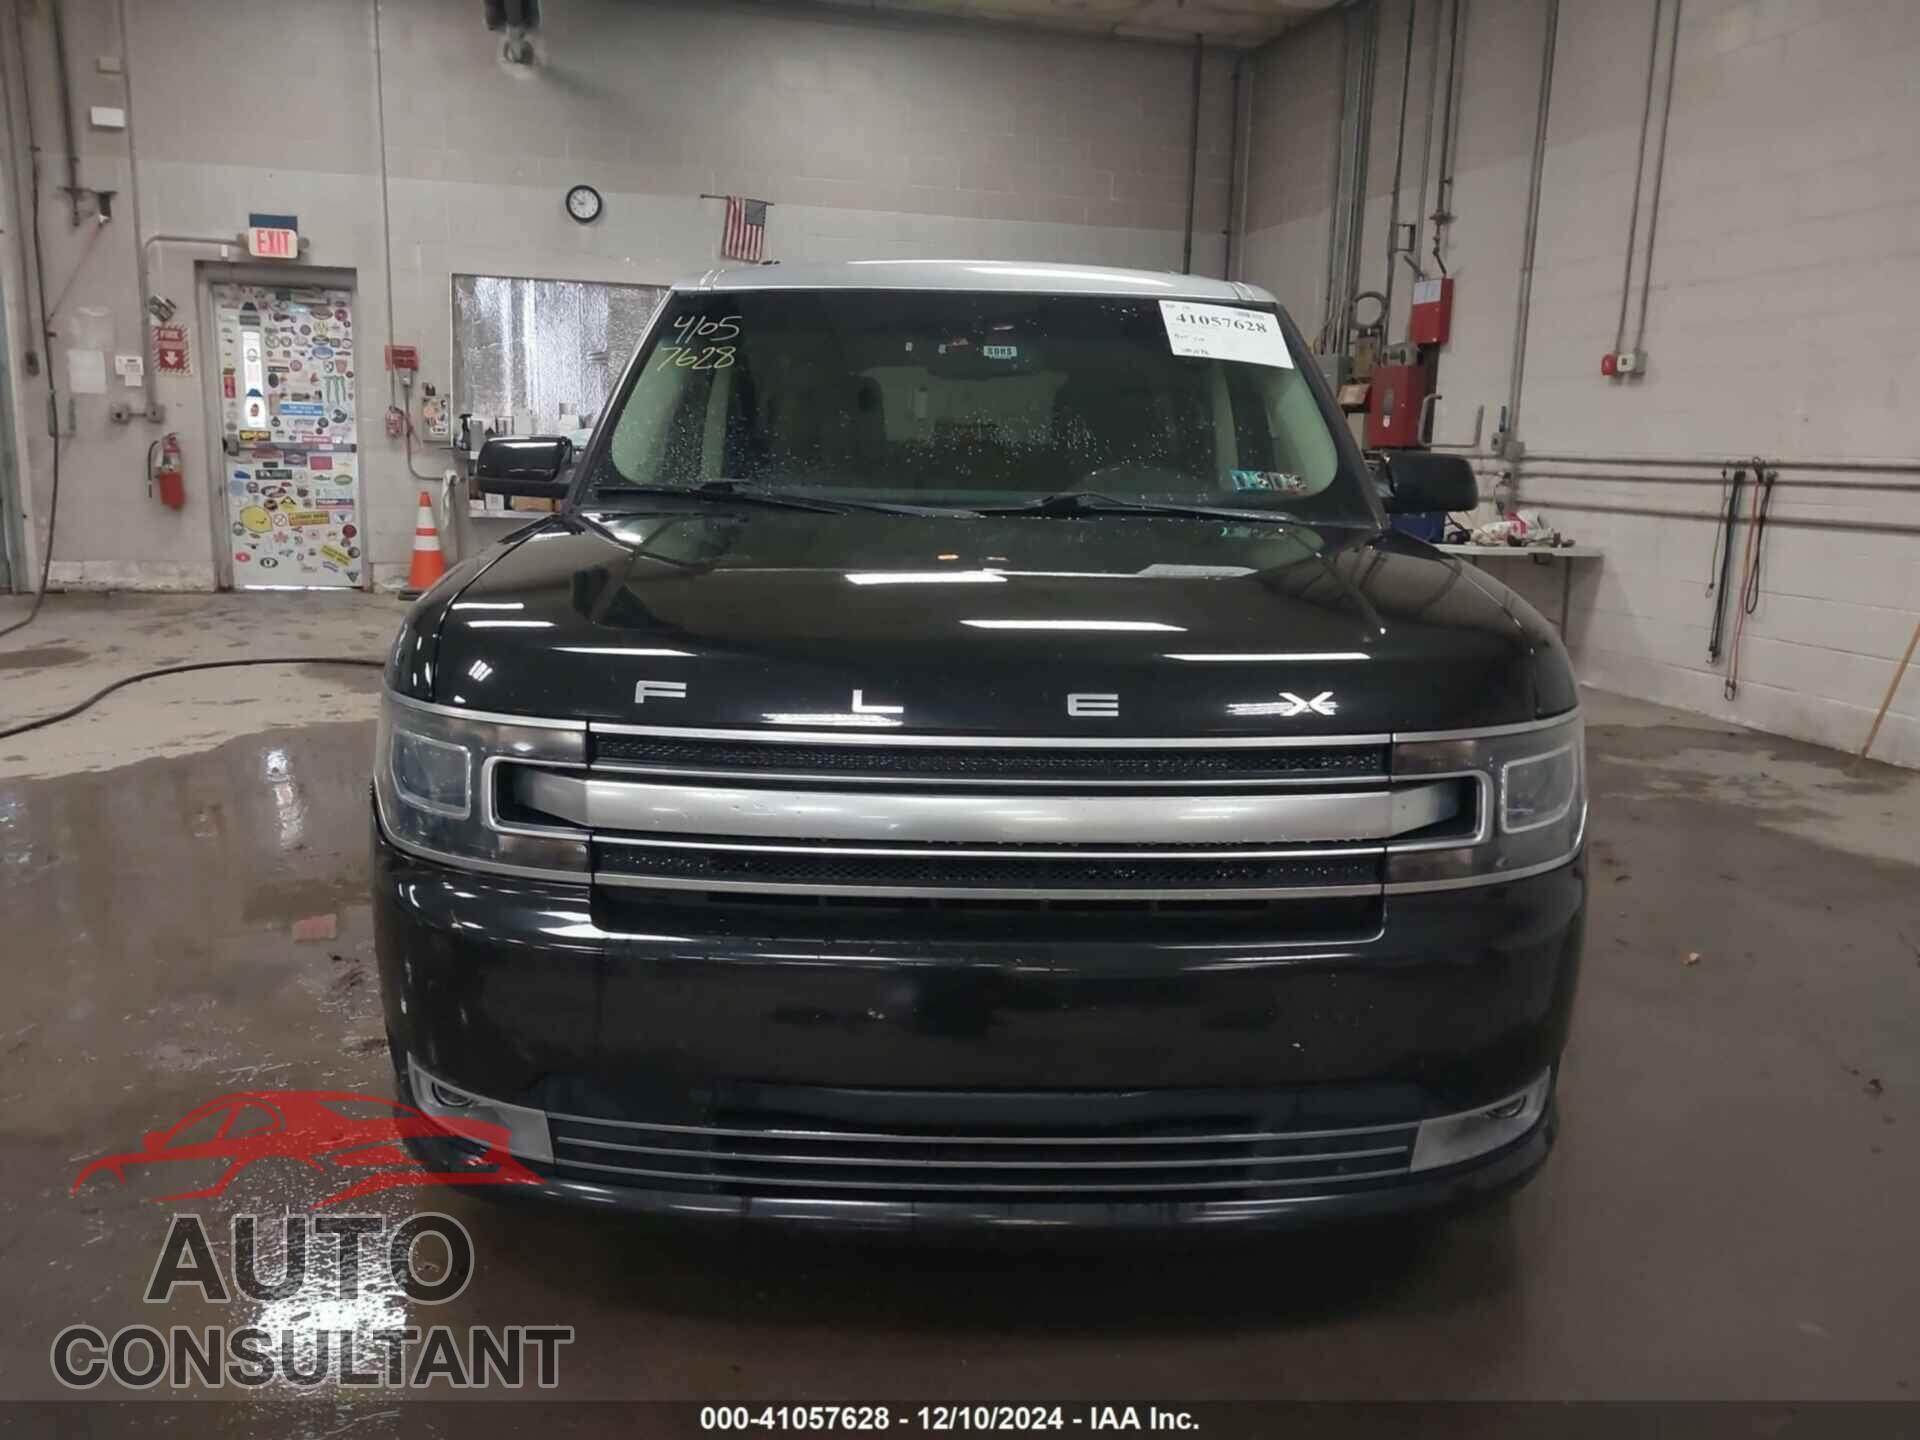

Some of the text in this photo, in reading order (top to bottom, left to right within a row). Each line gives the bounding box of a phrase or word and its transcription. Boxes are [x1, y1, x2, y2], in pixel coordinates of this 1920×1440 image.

[256, 229, 290, 256] EXIT
[673, 315, 743, 344] 4105
[1176, 313, 1267, 333] 41057628
[657, 346, 737, 371] 7628
[634, 680, 1336, 717] FLEX
